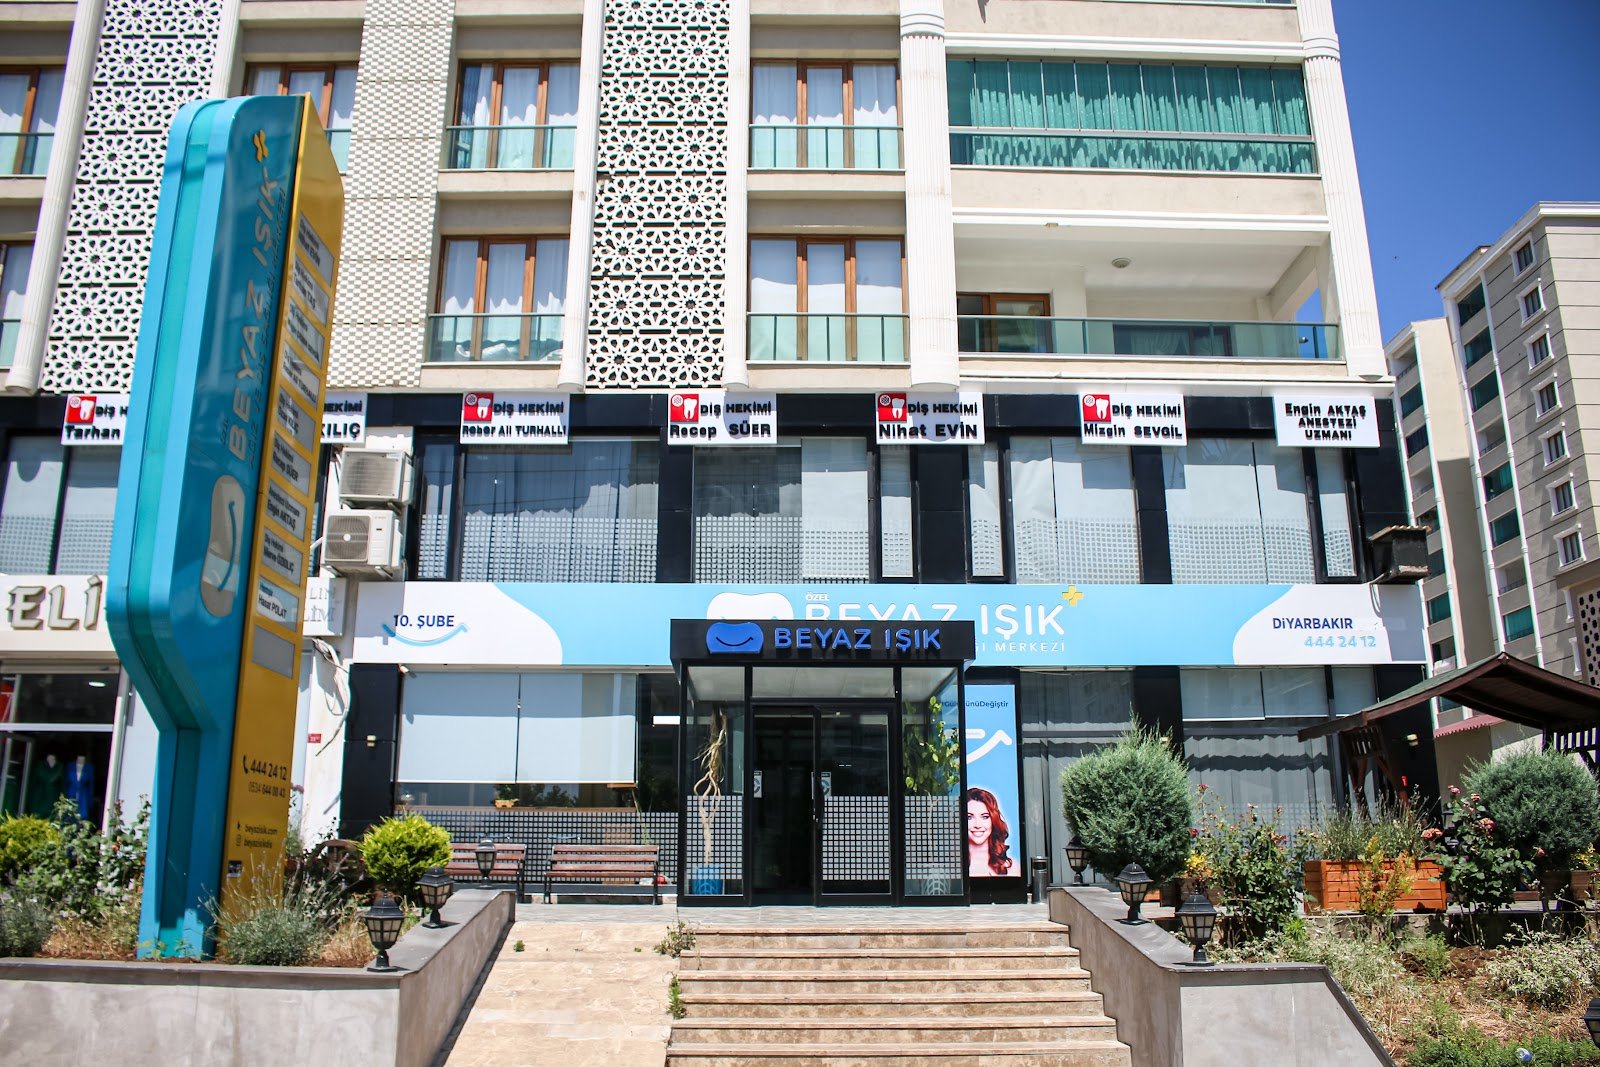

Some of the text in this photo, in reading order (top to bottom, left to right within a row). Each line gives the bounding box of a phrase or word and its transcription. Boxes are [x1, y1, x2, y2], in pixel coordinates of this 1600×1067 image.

[228, 166, 279, 461] BEYAZ IŞIK
[493, 401, 564, 418] DİŞ HEKİMİ
[700, 401, 771, 418] DİŞ HEKİMİ
[908, 401, 978, 415] DİŞ HEKİMİ
[1112, 403, 1181, 418] DİŞ HEKİMİ
[1327, 405, 1367, 419] AKTAŞ
[670, 420, 771, 440] Recep SÜER
[879, 421, 978, 438] Nihat EVİN
[1298, 416, 1357, 429] ANESTEZİ
[65, 425, 120, 439] Tarhan
[1084, 423, 1182, 439] Mizgin SEVGİL
[1305, 430, 1352, 440] UZMANI
[805, 592, 830, 601] ÖZEL
[272, 602, 286, 619] POLAT
[394, 615, 455, 629] 10. ŞUBE
[981, 604, 1065, 640] IŞIK
[774, 627, 941, 652] BEYAZ IŞIK
[995, 640, 1065, 652] MERKEZİ
[1304, 635, 1376, 648] 444 24 12
[250, 759, 266, 774] 444
[268, 763, 278, 778] 24
